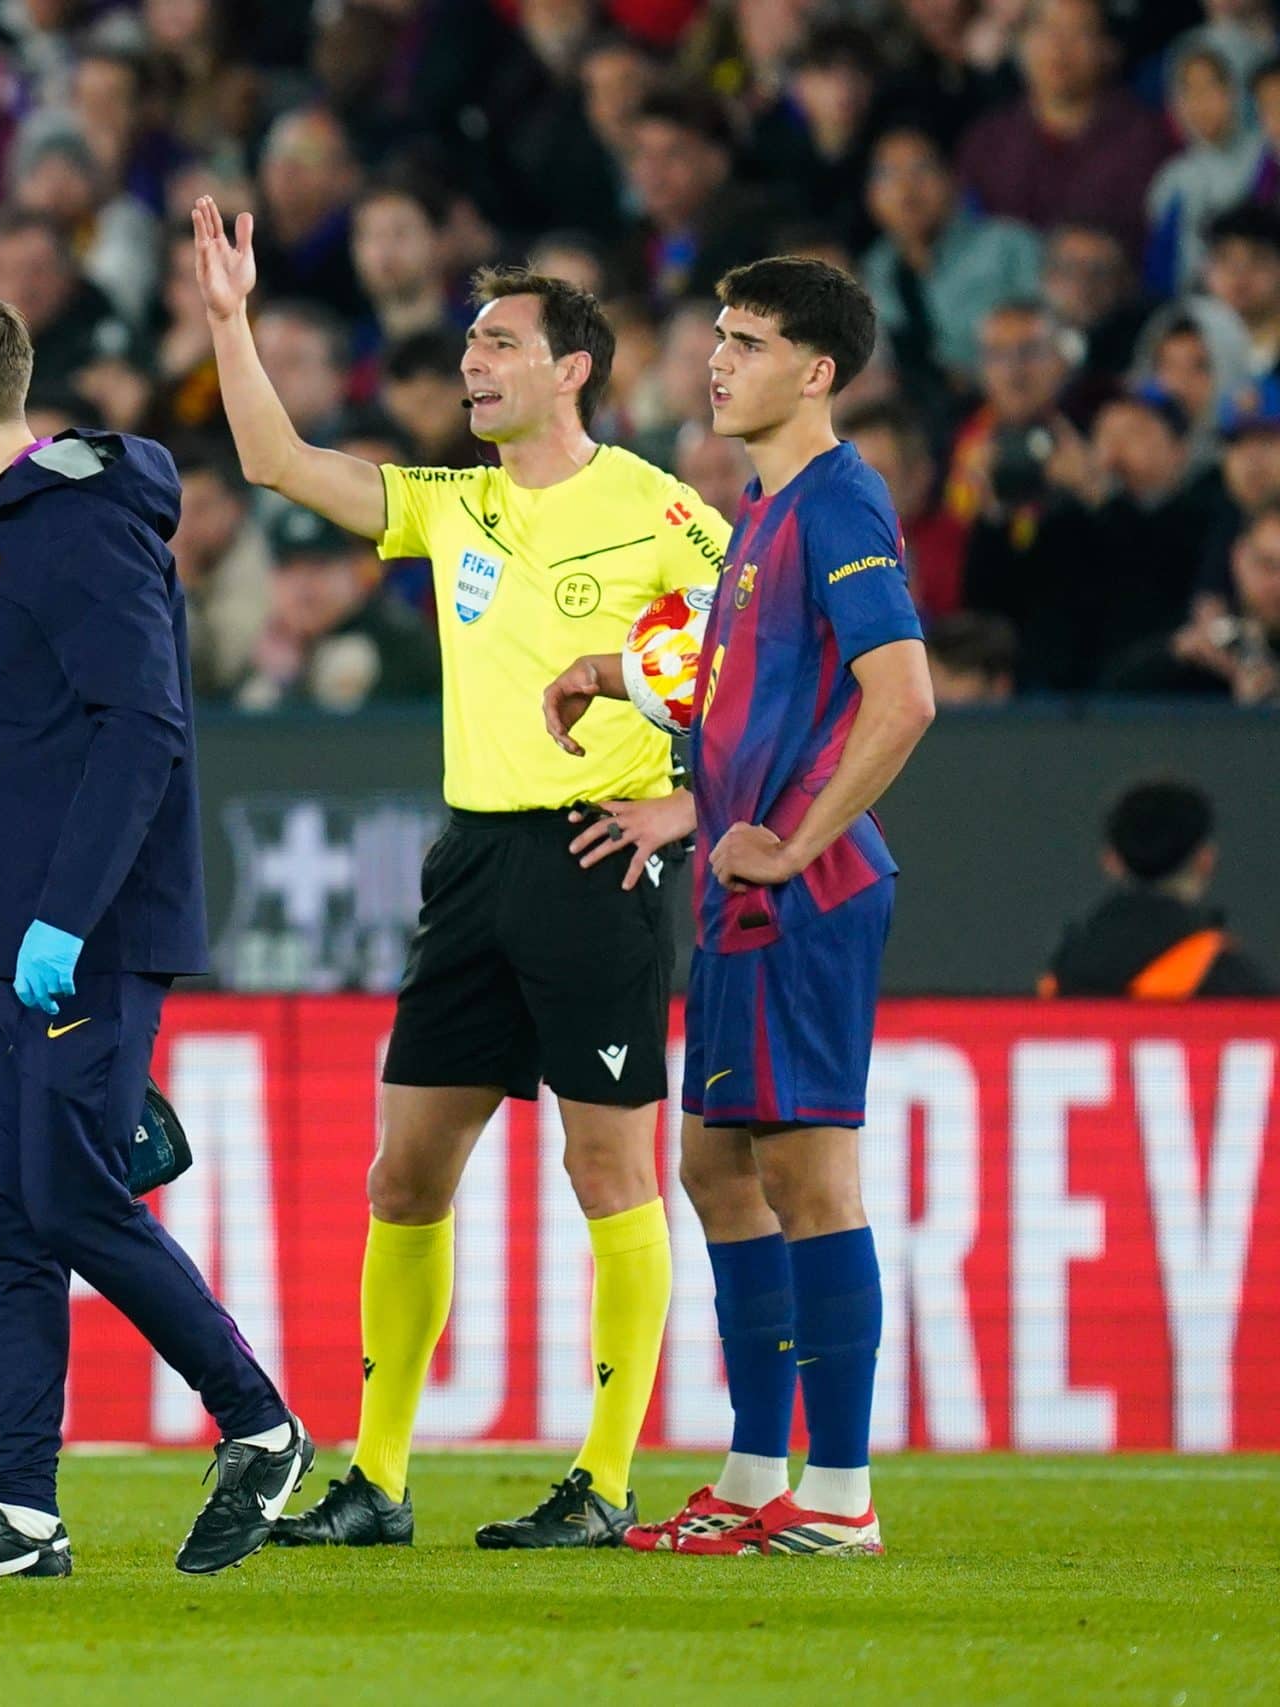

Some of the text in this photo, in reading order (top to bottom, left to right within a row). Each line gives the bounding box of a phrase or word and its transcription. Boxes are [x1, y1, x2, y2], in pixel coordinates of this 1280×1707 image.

[462, 552, 495, 578] FIFA
[828, 556, 887, 585] AMBILIGHT
[859, 1038, 1276, 1453] REY
